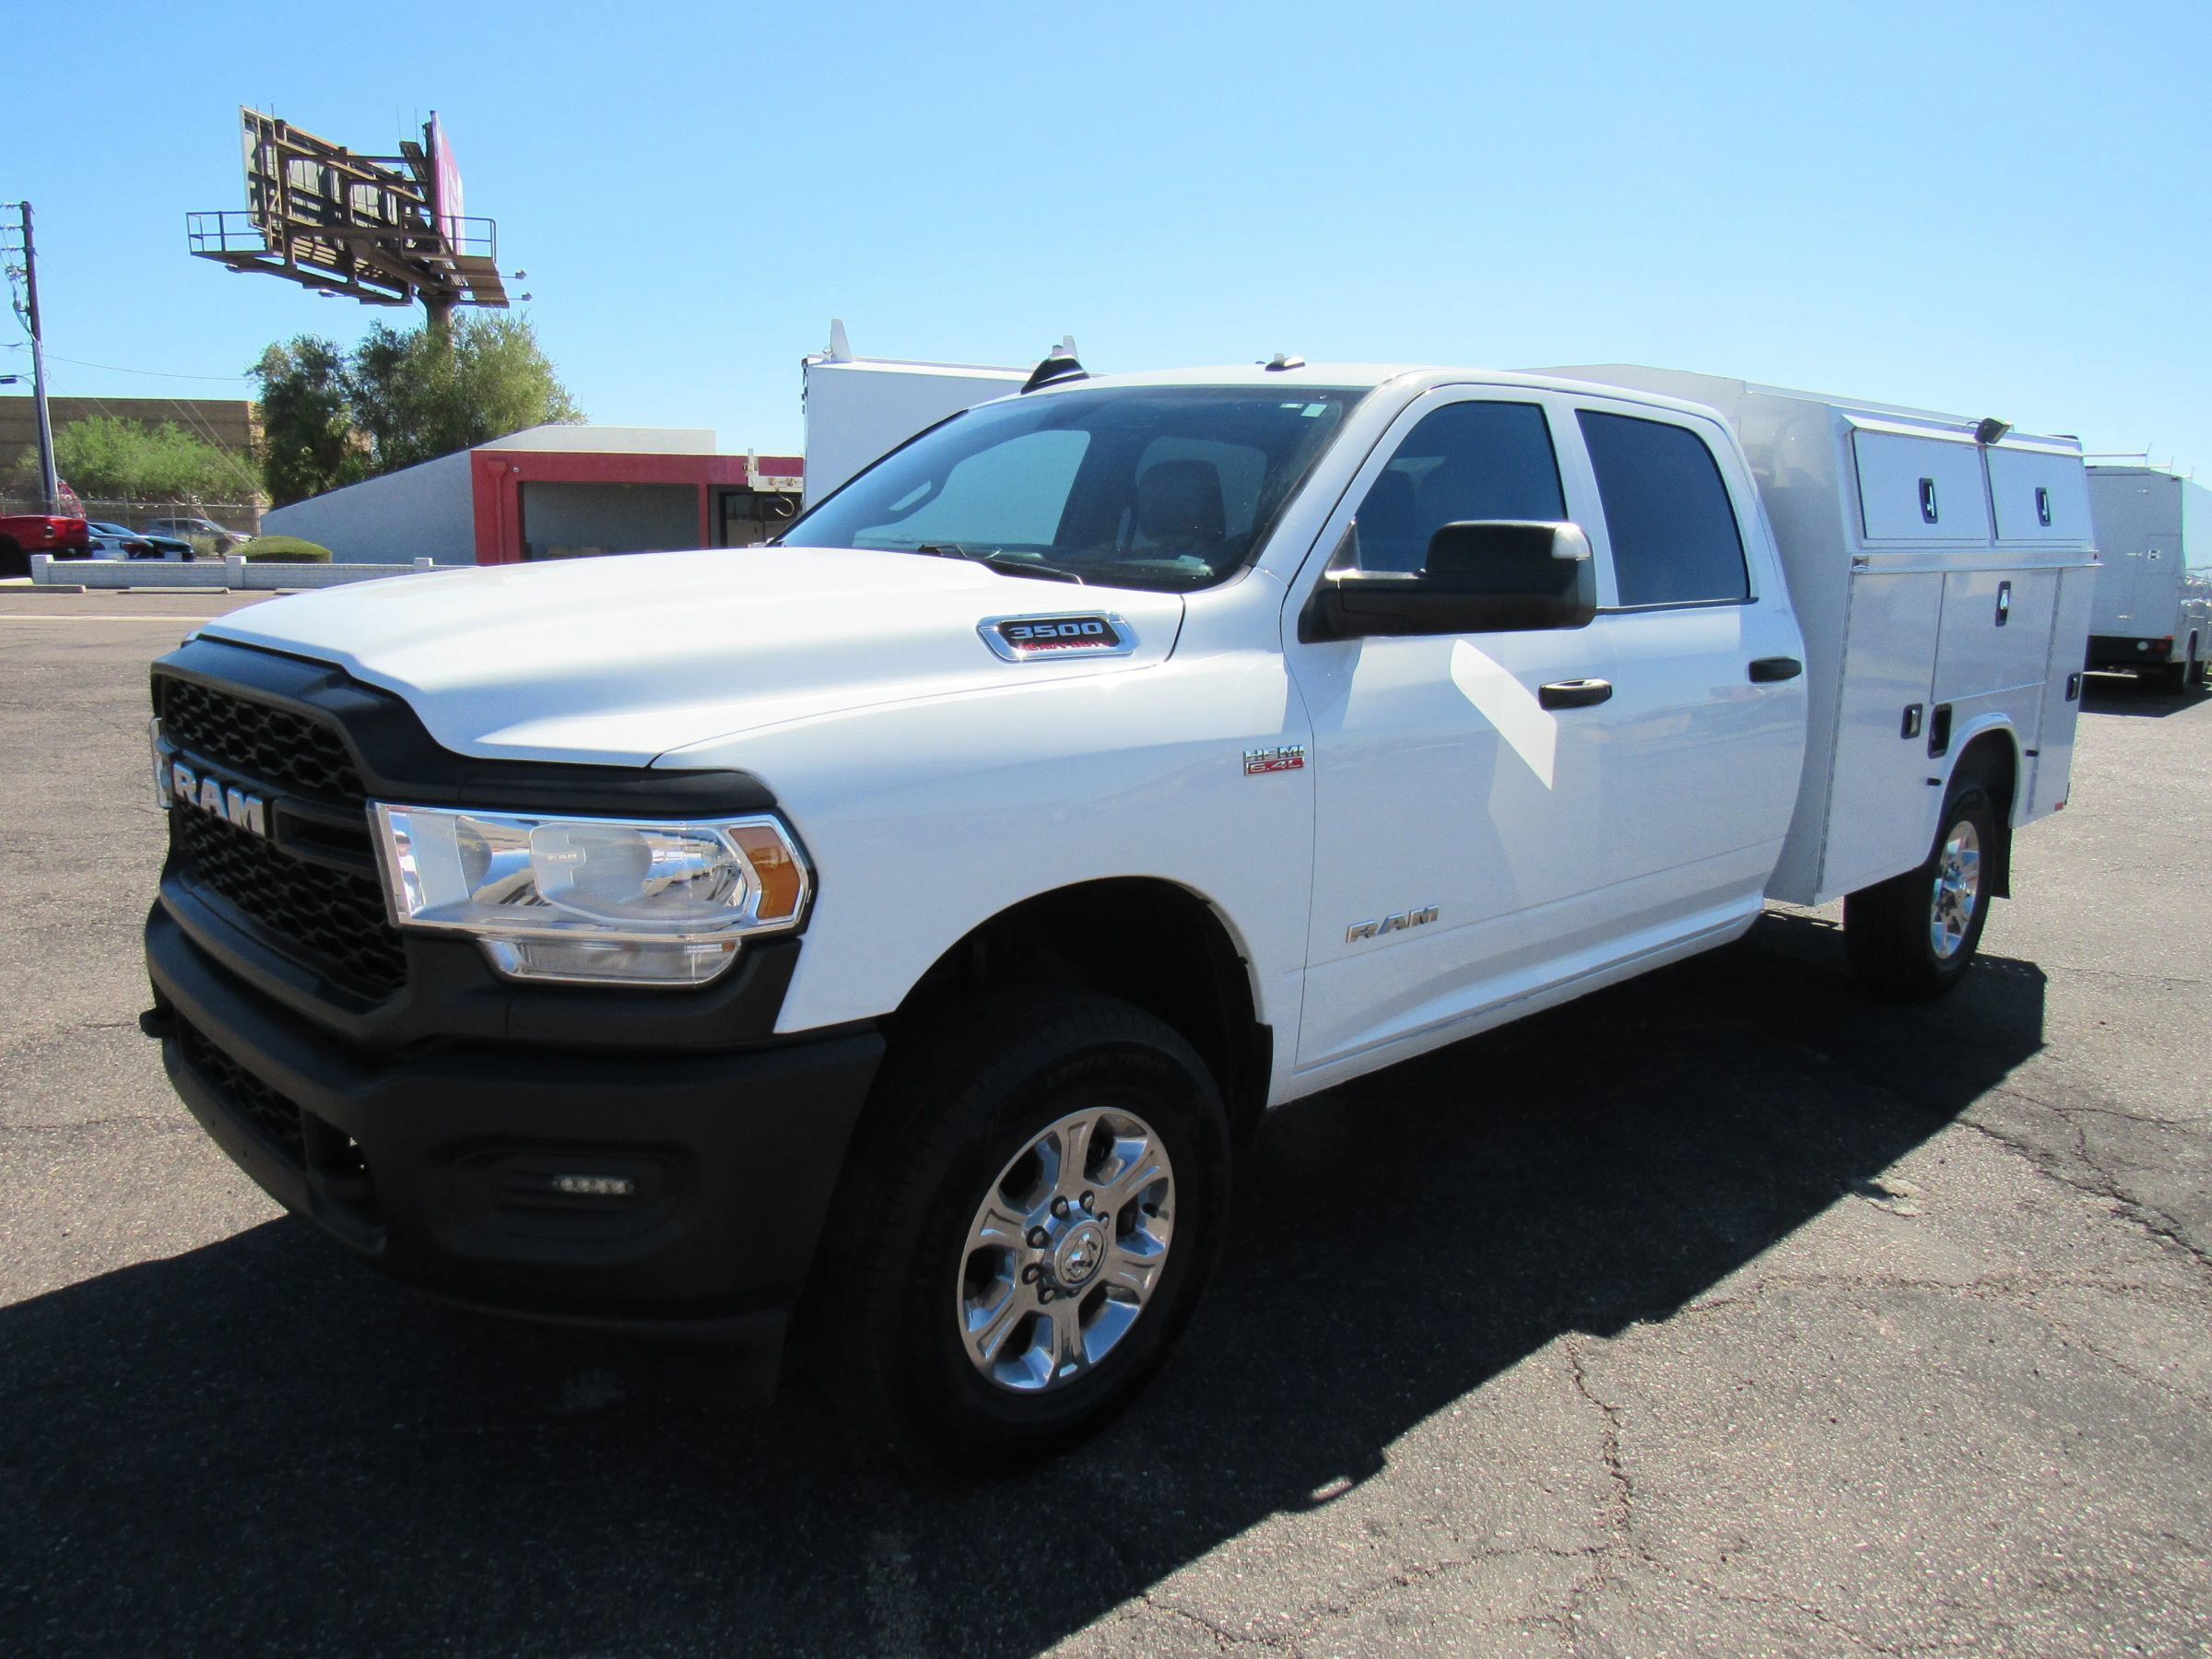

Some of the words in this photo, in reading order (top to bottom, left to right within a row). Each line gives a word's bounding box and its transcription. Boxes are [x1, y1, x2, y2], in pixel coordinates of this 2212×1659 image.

[1008, 622, 1103, 640] 3500
[1243, 745, 1305, 762] HEMI
[173, 761, 266, 839] RAM
[1346, 904, 1438, 943] RAM
